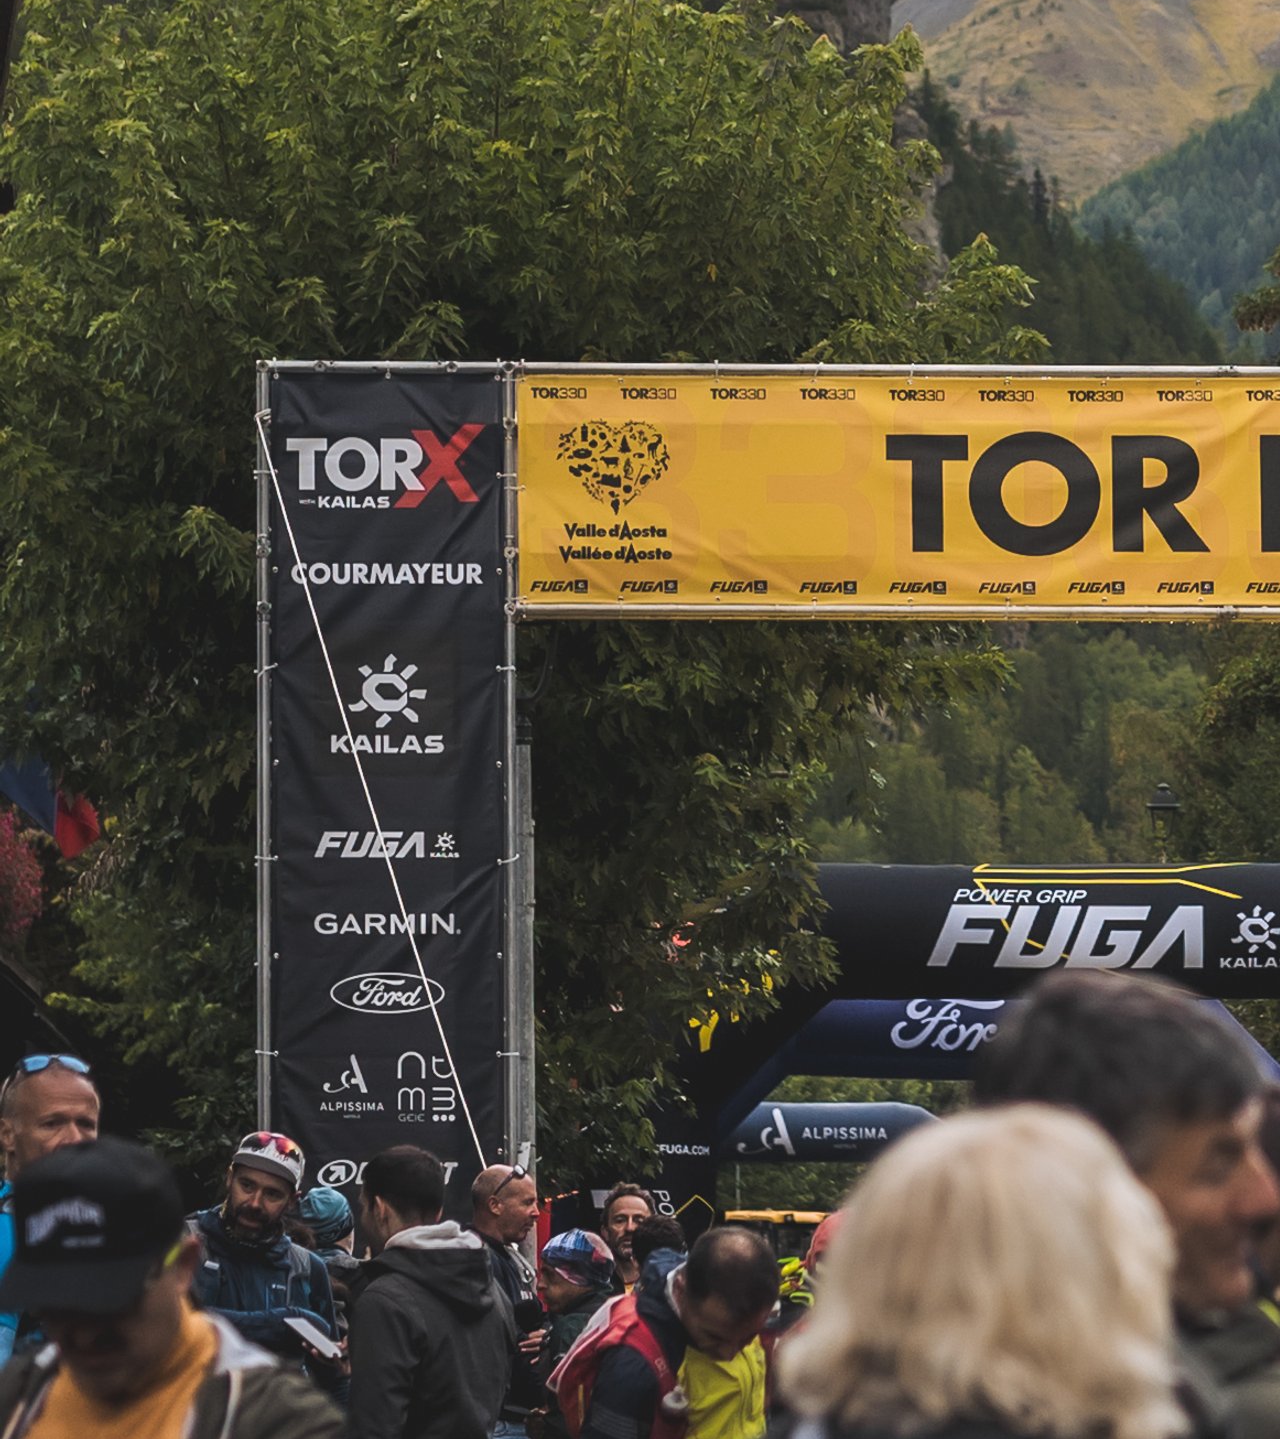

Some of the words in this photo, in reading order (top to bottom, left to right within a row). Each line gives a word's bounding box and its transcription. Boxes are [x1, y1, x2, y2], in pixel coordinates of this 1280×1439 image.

[530, 386, 587, 400] TOR330
[620, 387, 677, 400] TOR330
[709, 387, 767, 400] TOR330
[799, 387, 856, 401] TOR330
[888, 389, 945, 402] TOR330
[977, 388, 1035, 403] TOR330
[1067, 389, 1124, 403] TOR330
[1156, 389, 1213, 403] TOR330
[286, 423, 486, 508] TORX
[318, 496, 390, 509] KAILAS
[885, 431, 1211, 557] TOR
[564, 522, 607, 541] Valle
[559, 546, 613, 564] Vallée
[290, 563, 483, 585] COURMAYEUR
[529, 579, 574, 594] FUGA
[619, 580, 664, 594] FUGA
[709, 580, 754, 595] FUGA
[799, 581, 844, 595] FUGA
[888, 581, 933, 595] FUGA
[978, 582, 1022, 595] FUGA
[1067, 582, 1111, 595] FUGA
[1156, 581, 1201, 595] FUGA
[330, 734, 445, 754] KAILAS
[314, 831, 425, 858] FUGA
[953, 888, 1031, 904] POWER
[1036, 889, 1087, 904] GRIP
[927, 904, 1204, 969] FUGA
[352, 977, 422, 1007] Ford
[890, 999, 998, 1052] For
[320, 1101, 384, 1112] ALPISSIMA
[802, 1126, 887, 1140] ALPISSIMA
